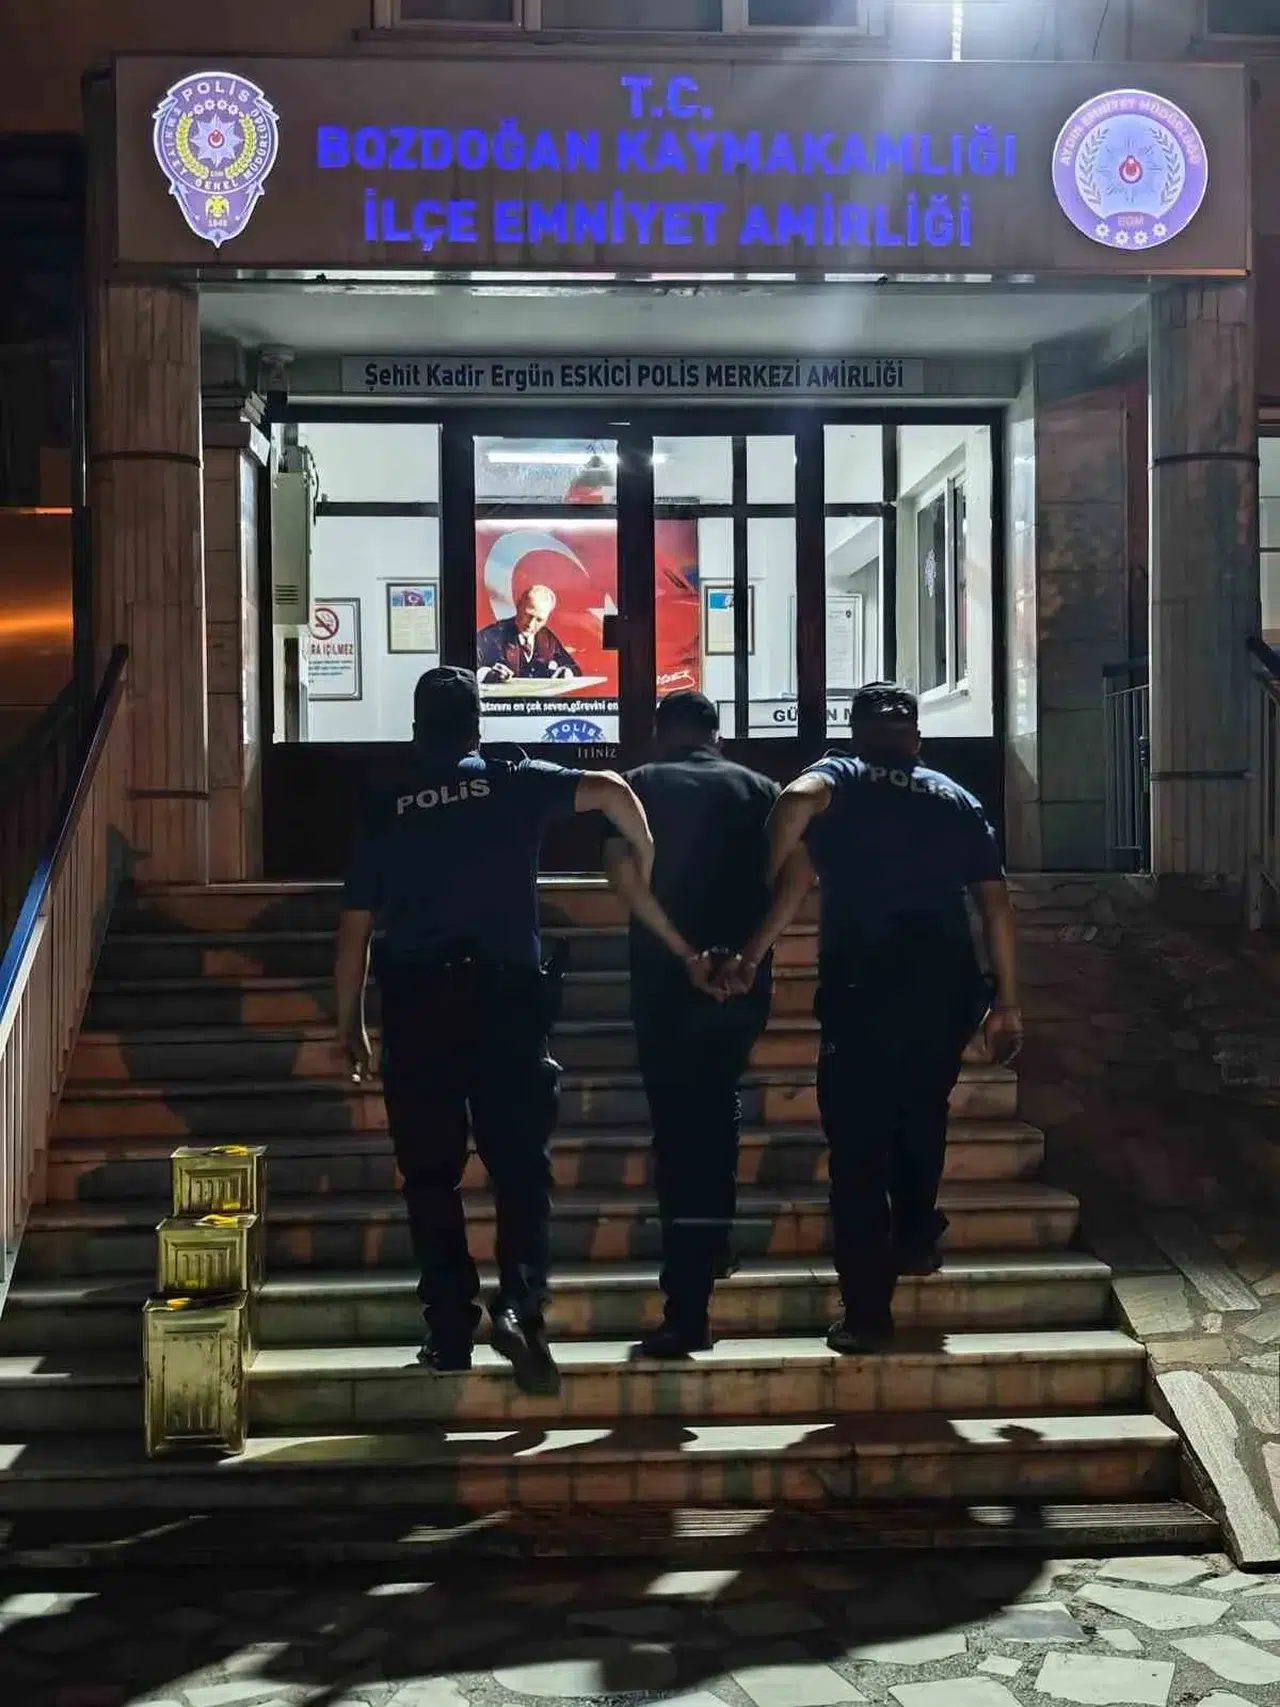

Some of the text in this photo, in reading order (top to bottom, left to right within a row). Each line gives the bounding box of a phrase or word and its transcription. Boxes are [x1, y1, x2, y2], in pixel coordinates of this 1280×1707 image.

[182, 80, 250, 102] POLİS
[620, 76, 714, 119] T.C.
[317, 116, 1016, 176] BOZDOĞAN KAYMAKAMLIĞI
[364, 187, 972, 251] İLÇE EMNİYET AMİRLİĞİ
[364, 358, 904, 392] Şehit Kadir Ergün ESKİCİ POLİS MERKEZİ AMİRLİĞİ
[551, 723, 596, 737] POLİS
